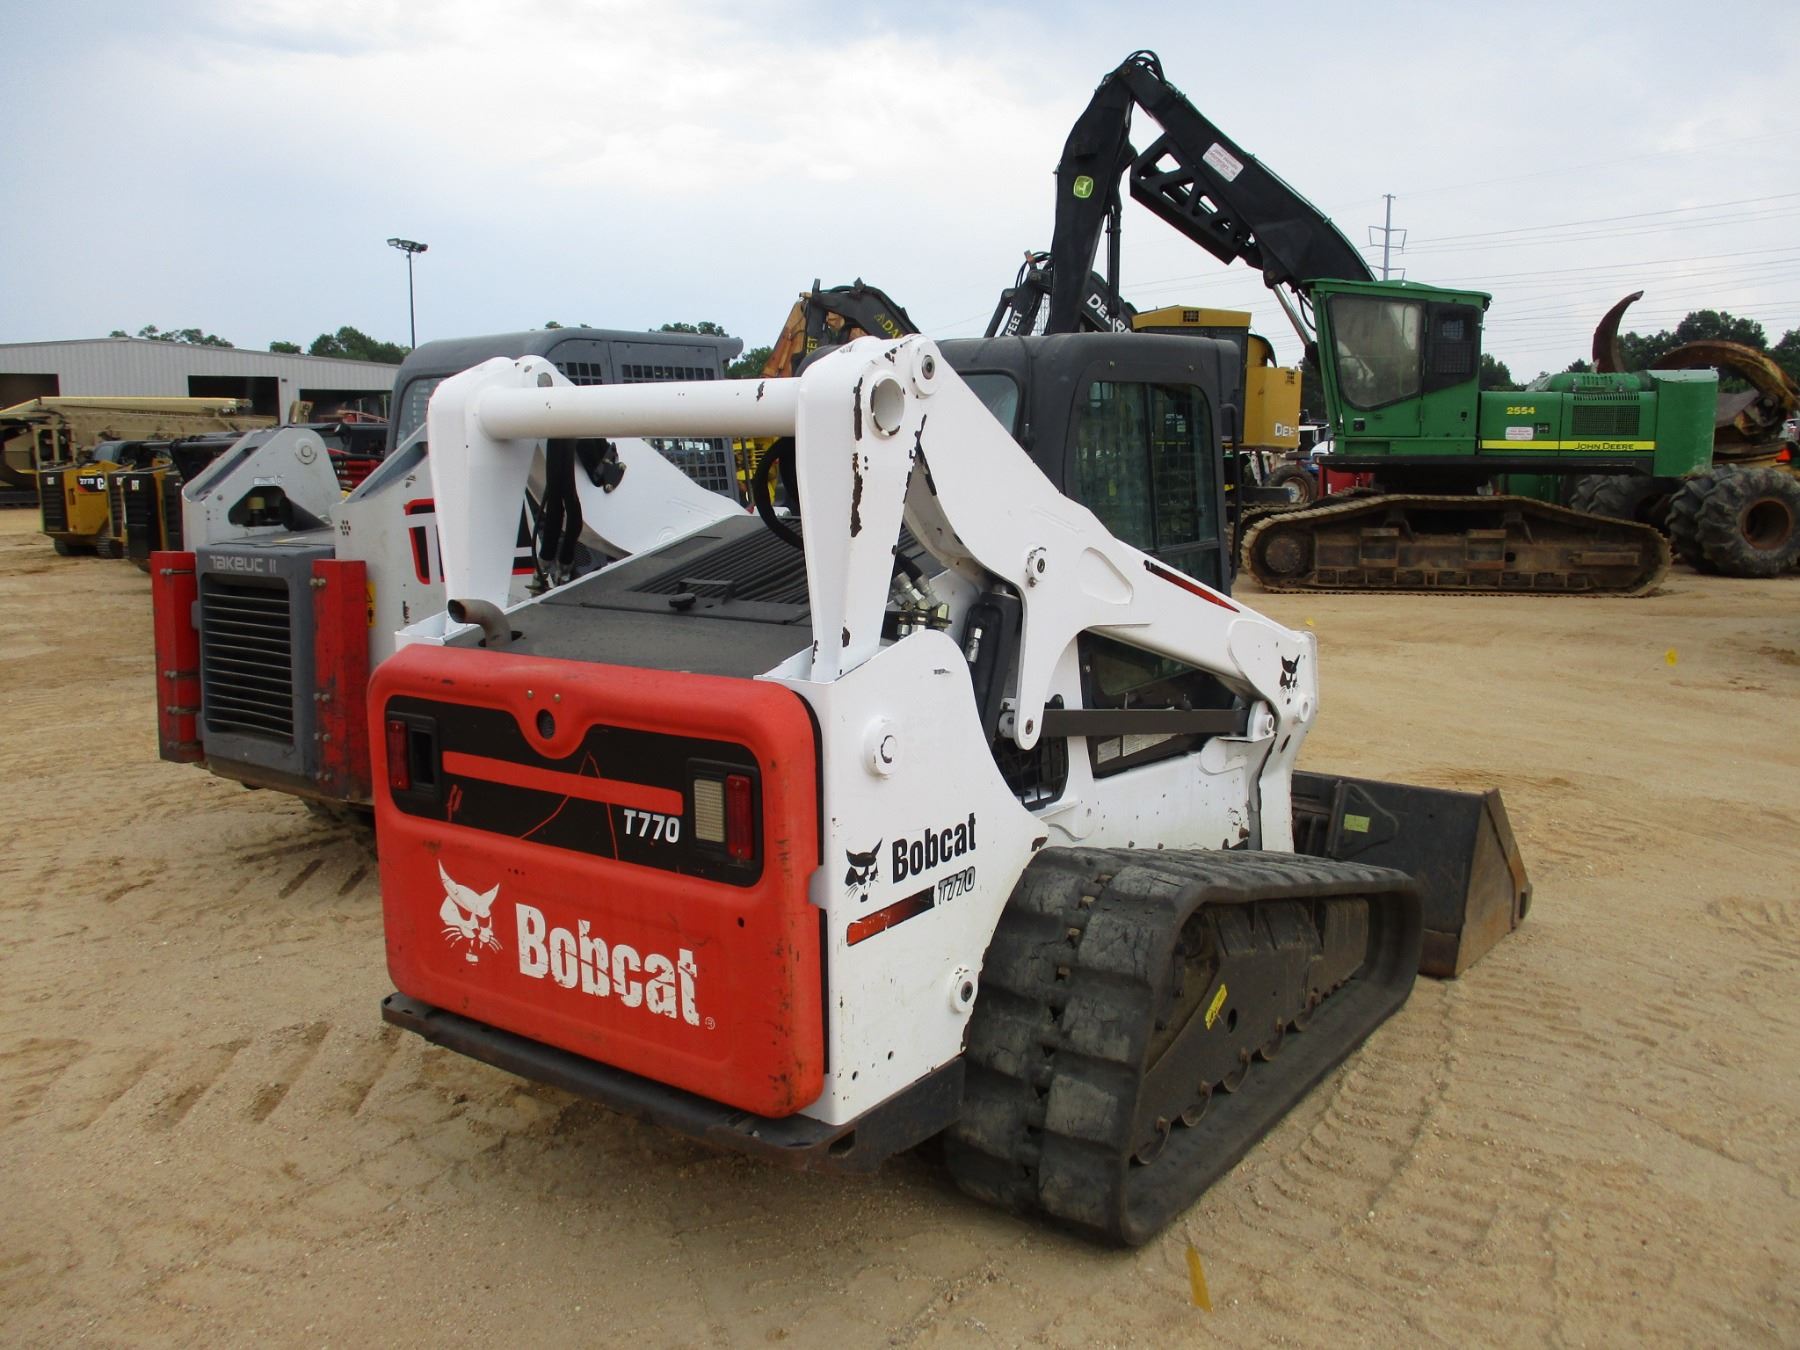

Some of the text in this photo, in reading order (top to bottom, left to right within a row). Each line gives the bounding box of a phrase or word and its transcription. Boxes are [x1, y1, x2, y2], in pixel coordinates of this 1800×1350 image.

[1506, 406, 1536, 415] 2554
[1575, 442, 1634, 450] JOHN DEERE
[624, 809, 680, 844] T770
[892, 812, 976, 884] Bobcat
[938, 866, 976, 905] T770
[515, 903, 700, 1026] Bobcat
